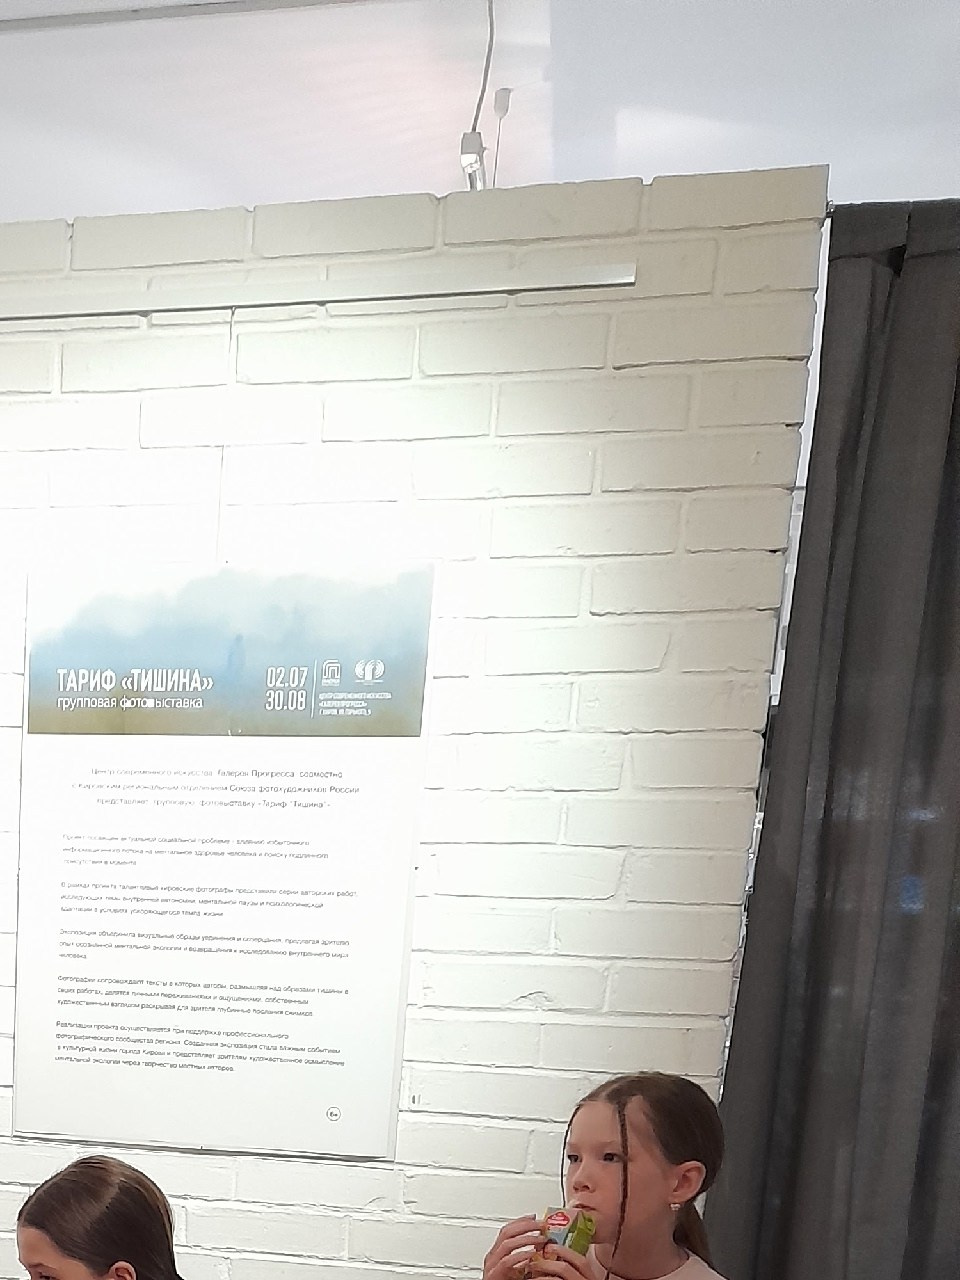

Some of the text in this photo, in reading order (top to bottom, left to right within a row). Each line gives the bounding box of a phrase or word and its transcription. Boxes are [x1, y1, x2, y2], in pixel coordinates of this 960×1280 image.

[56, 668, 214, 692] ТАРИФ «ТИШИНА»
[267, 666, 309, 688] 02.07
[57, 695, 203, 711] групповая фотоыставка
[265, 689, 307, 711] 30.08
